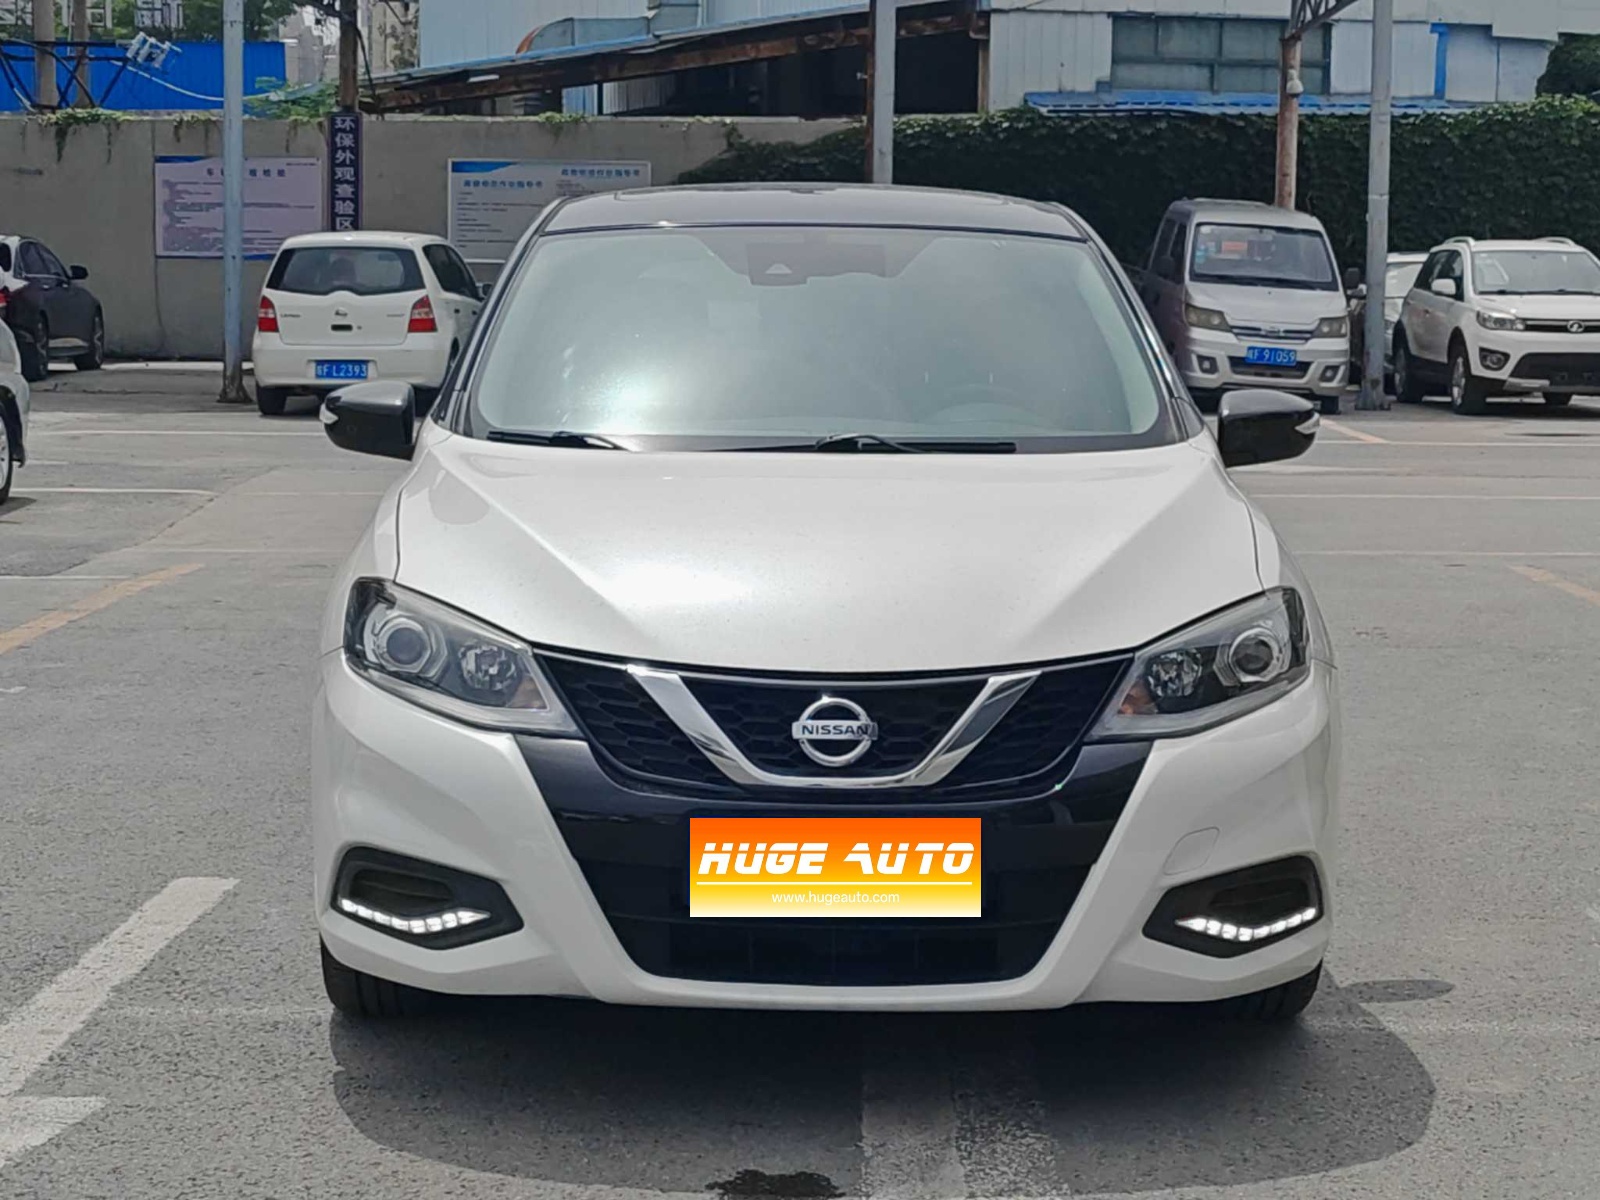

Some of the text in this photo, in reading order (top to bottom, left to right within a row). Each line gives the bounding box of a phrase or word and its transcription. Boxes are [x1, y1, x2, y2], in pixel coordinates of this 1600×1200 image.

[334, 116, 355, 230] 环保外观查验区
[801, 724, 868, 735] NISSAN
